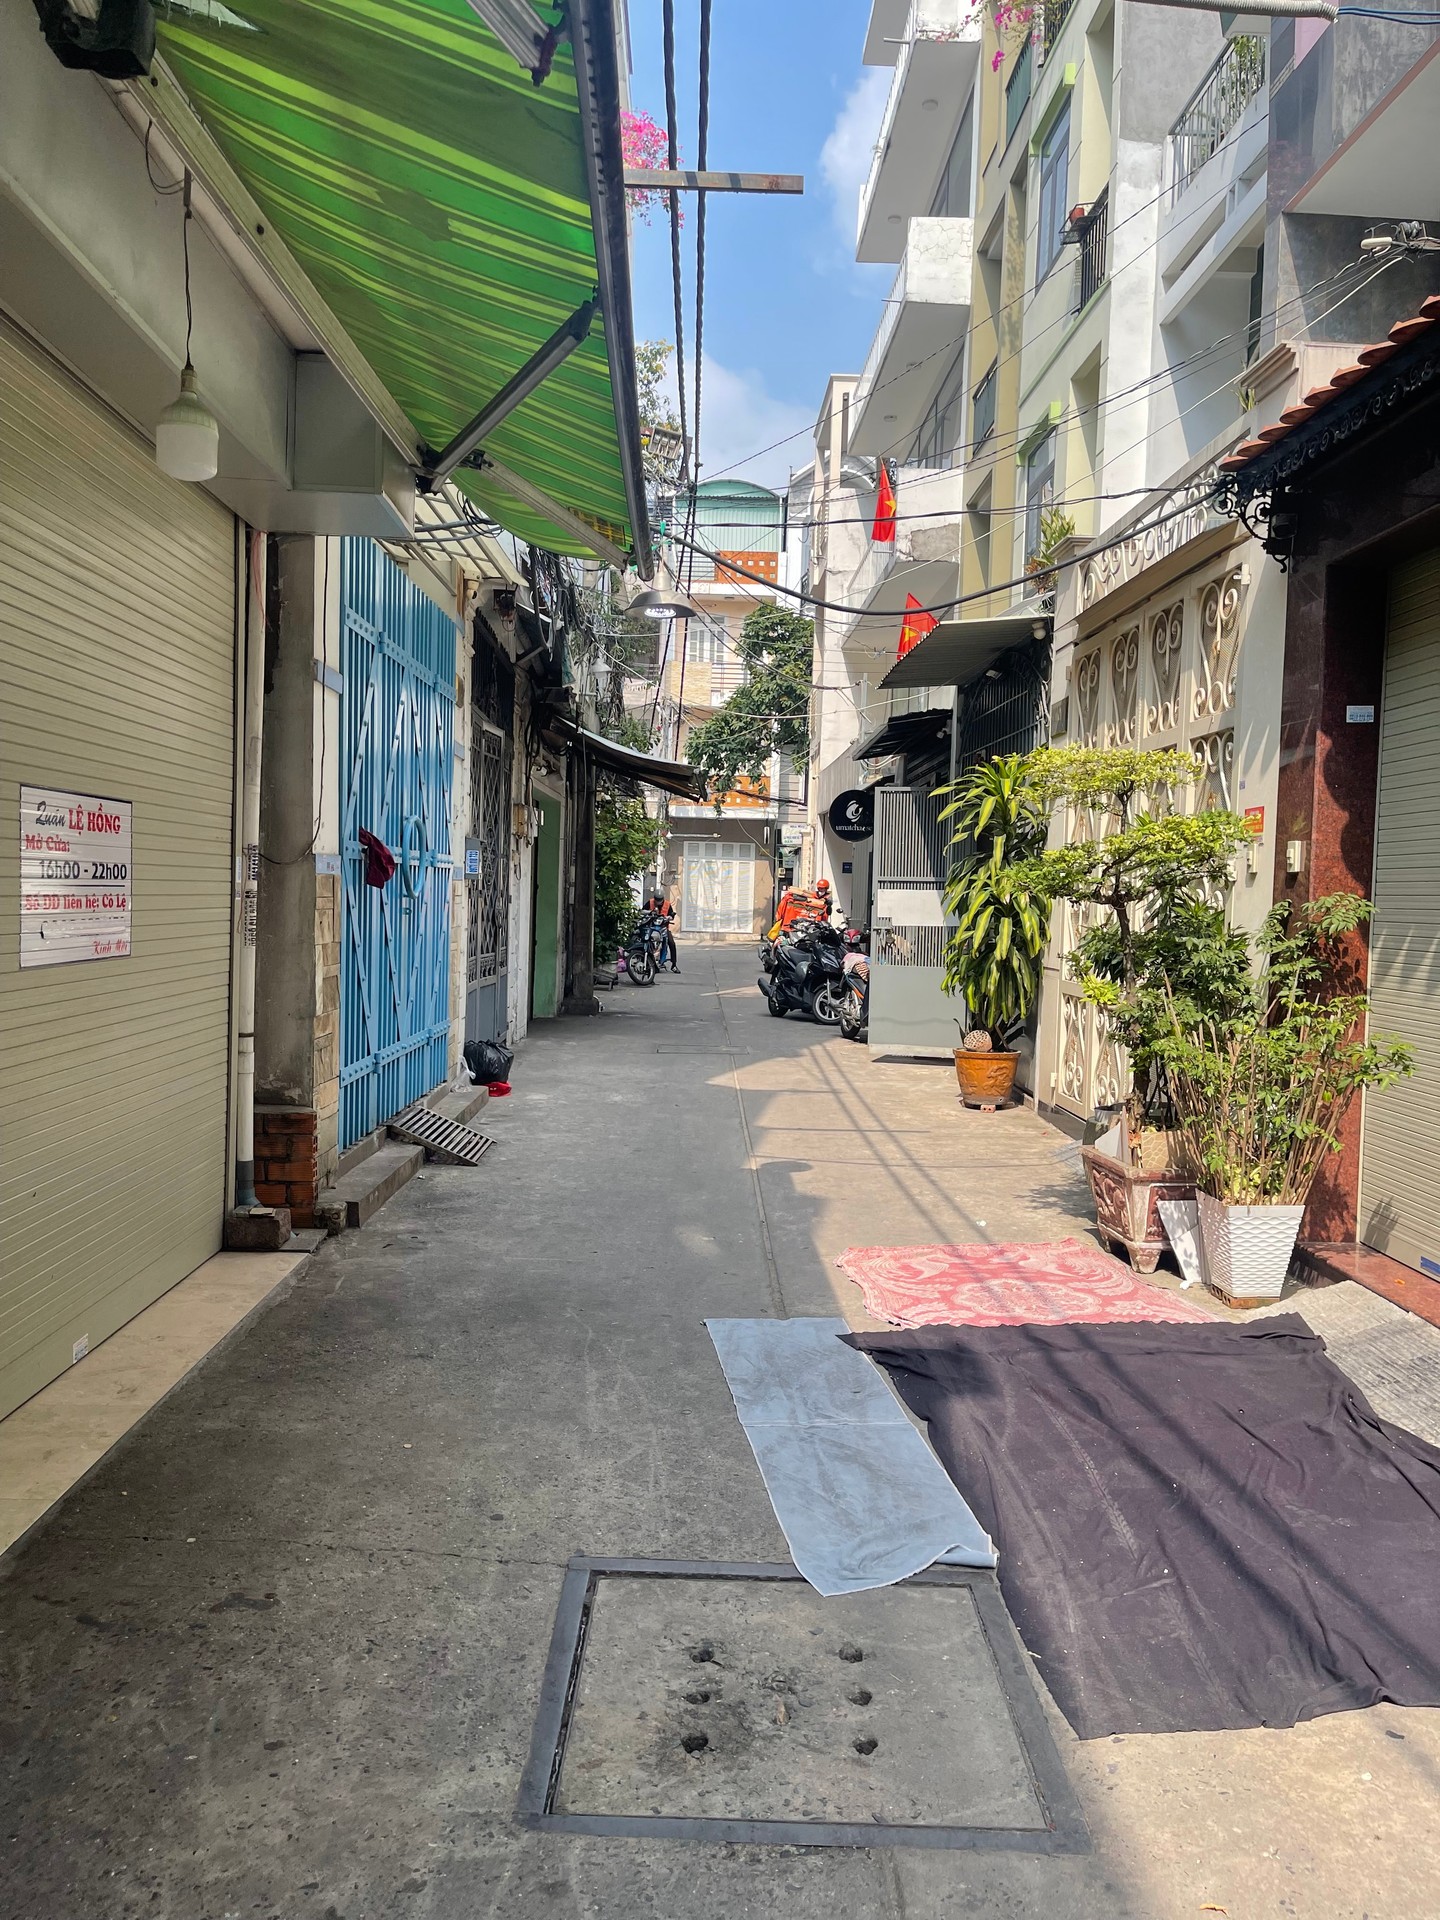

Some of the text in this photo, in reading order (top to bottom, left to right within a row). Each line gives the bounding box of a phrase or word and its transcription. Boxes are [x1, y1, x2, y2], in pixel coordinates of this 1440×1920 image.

[69, 804, 84, 835] LỆ
[87, 802, 121, 834] HỒNG
[26, 833, 43, 849] Mở
[39, 860, 80, 879] 16h00
[91, 861, 127, 880] 22h00
[63, 893, 82, 909] liên
[85, 893, 99, 912] hệ:
[102, 893, 114, 908] Cô
[116, 893, 126, 912] Lệ
